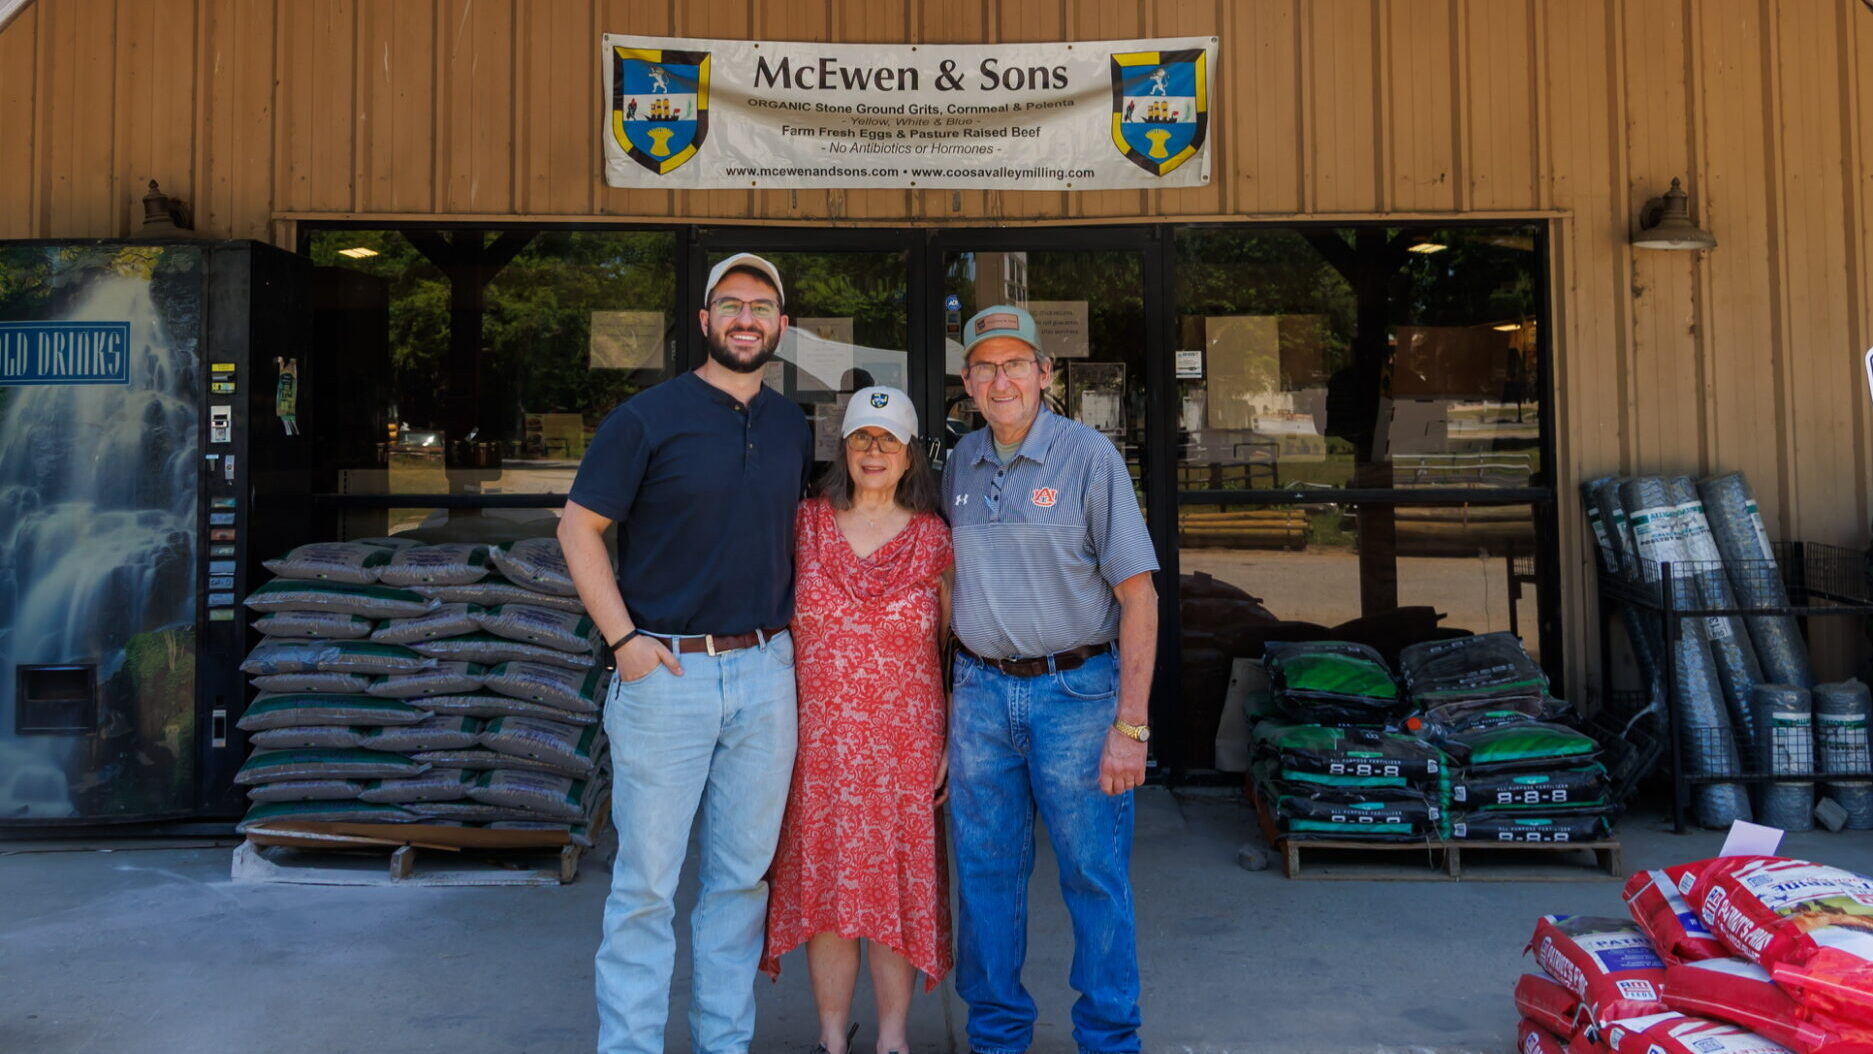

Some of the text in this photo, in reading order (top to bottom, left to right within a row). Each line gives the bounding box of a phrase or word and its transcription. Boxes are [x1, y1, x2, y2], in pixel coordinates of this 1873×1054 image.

[753, 55, 1069, 92] McEwen & Sons
[747, 98, 1075, 116] ORGANIC Stone Ground Grits, Cornmeal & Polenta
[851, 116, 890, 127] Yellow,
[895, 117, 930, 127] White
[933, 118, 942, 126] &
[946, 117, 973, 126] Blue
[781, 125, 1041, 141] Farm Fresh Eggs & Pasture Raised Beef
[829, 142, 847, 153] No
[849, 142, 912, 154] Antibiotics
[915, 144, 927, 154] or
[930, 143, 994, 154] Hormones
[726, 165, 899, 177] www.mcewenandsons.com
[911, 166, 1095, 180] www.coosavalleymilling.com
[0, 331, 29, 377] LD
[1328, 763, 1400, 777] 8-8-8
[1496, 788, 1568, 804] 8-8-8
